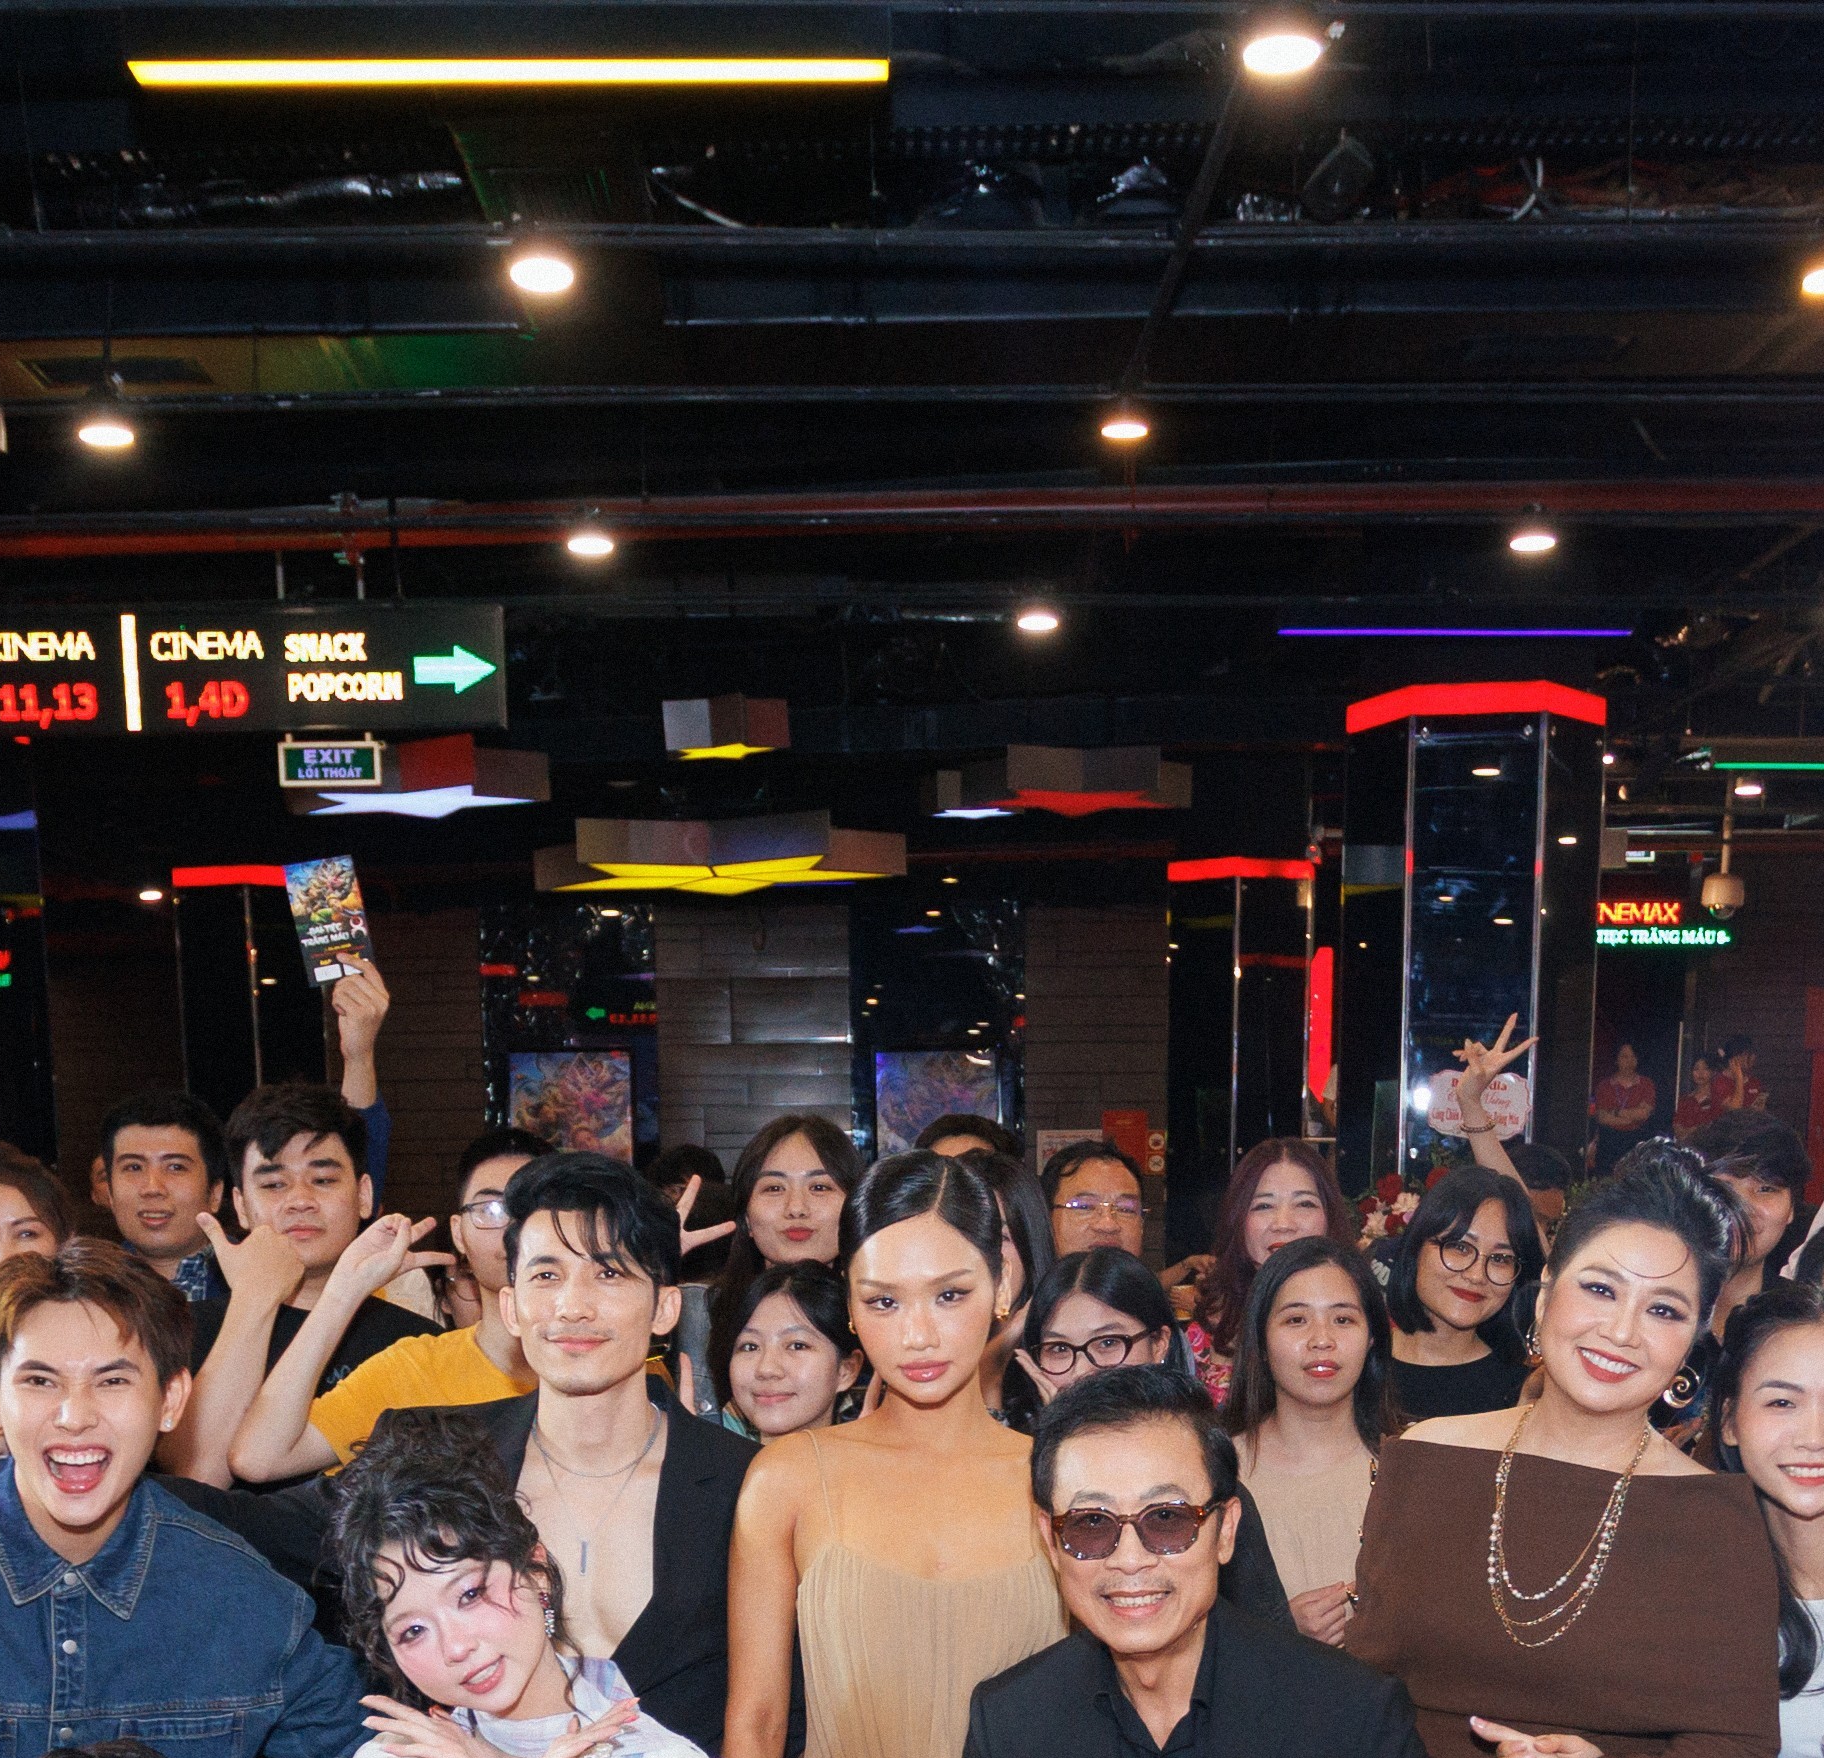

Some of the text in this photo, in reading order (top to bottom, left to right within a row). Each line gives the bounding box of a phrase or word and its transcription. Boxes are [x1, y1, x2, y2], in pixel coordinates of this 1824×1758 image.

[150, 631, 264, 661] CINEMA
[284, 633, 368, 662] SNACK
[287, 671, 404, 702] POPCORN
[165, 681, 250, 727] 1,4D
[303, 749, 356, 764] EXIT
[321, 763, 362, 779] THOÁT
